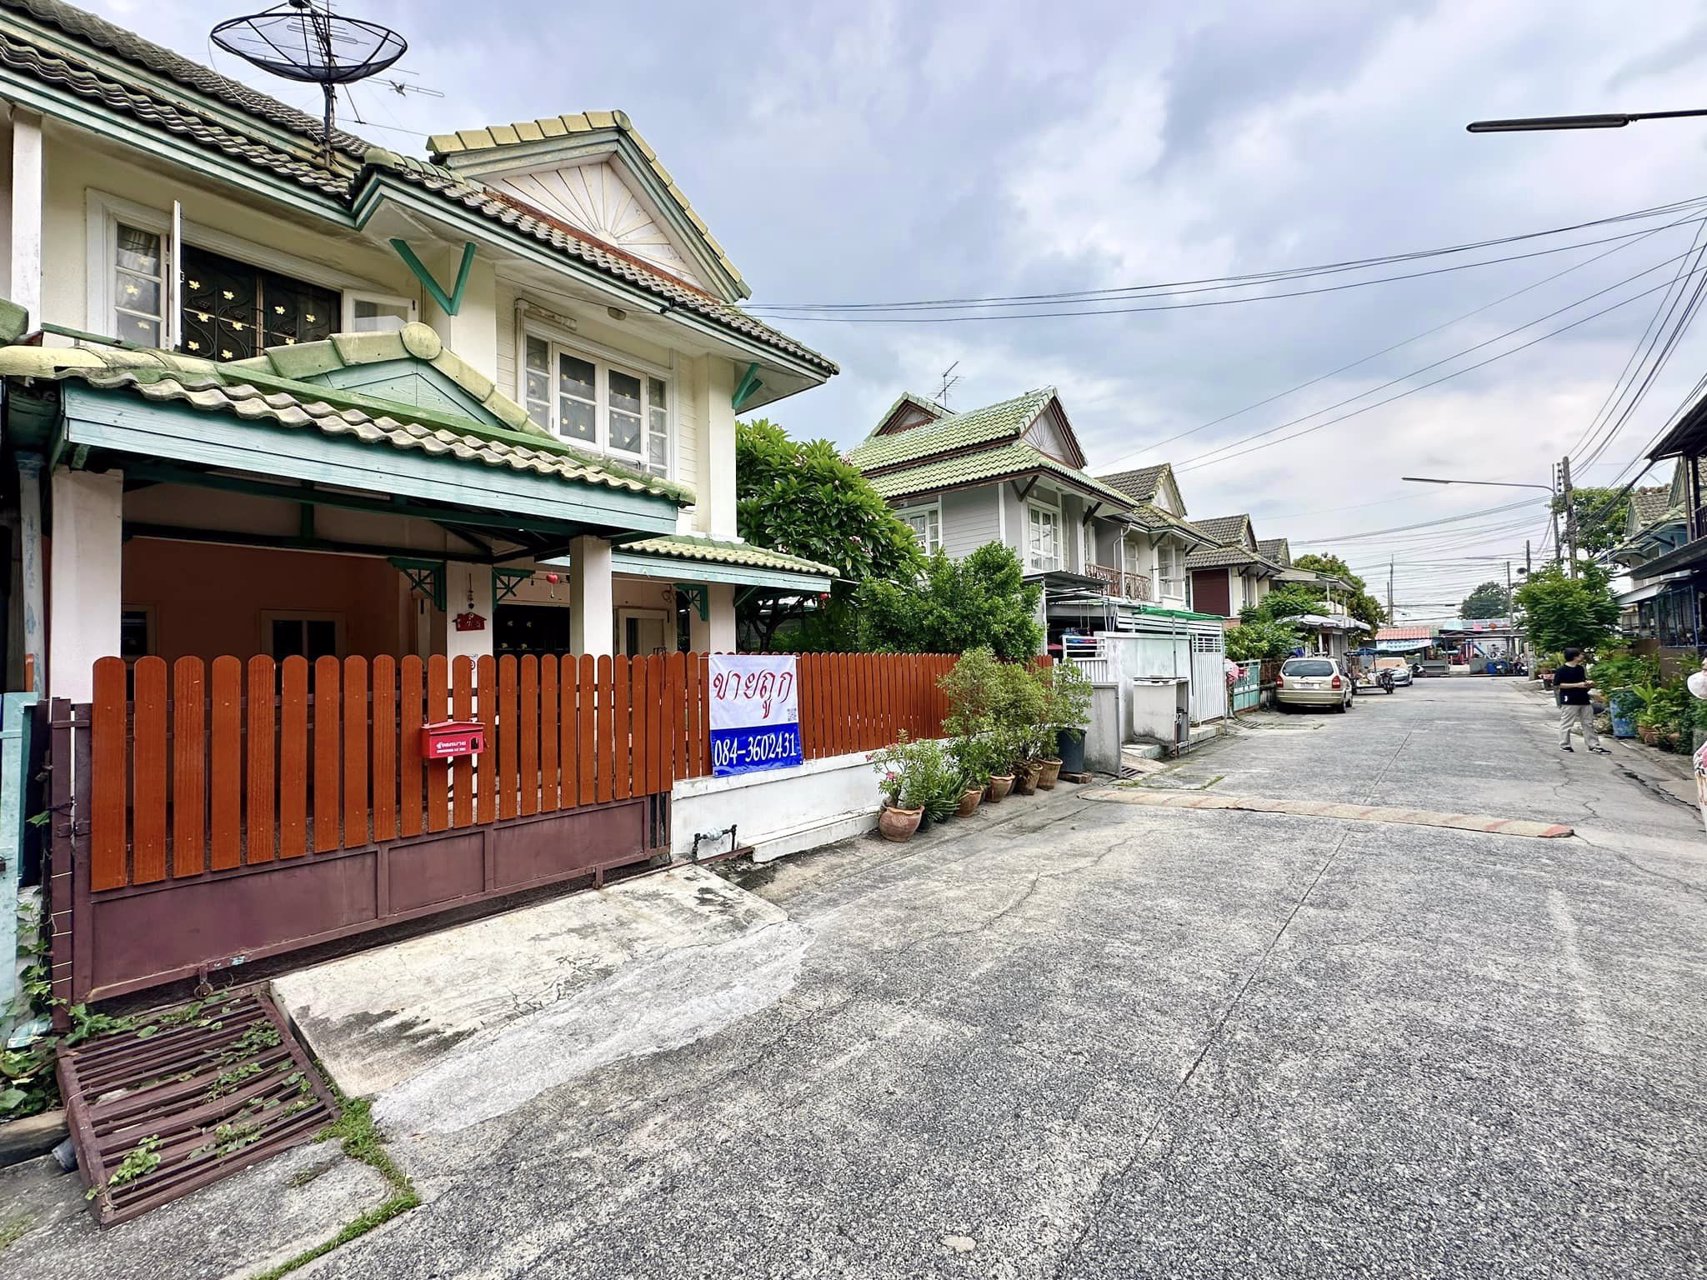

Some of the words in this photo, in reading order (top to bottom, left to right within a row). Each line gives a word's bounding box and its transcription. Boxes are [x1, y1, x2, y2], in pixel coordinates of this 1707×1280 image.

[713, 669, 794, 719] ขายถูก
[714, 731, 797, 766] 084-3602431
